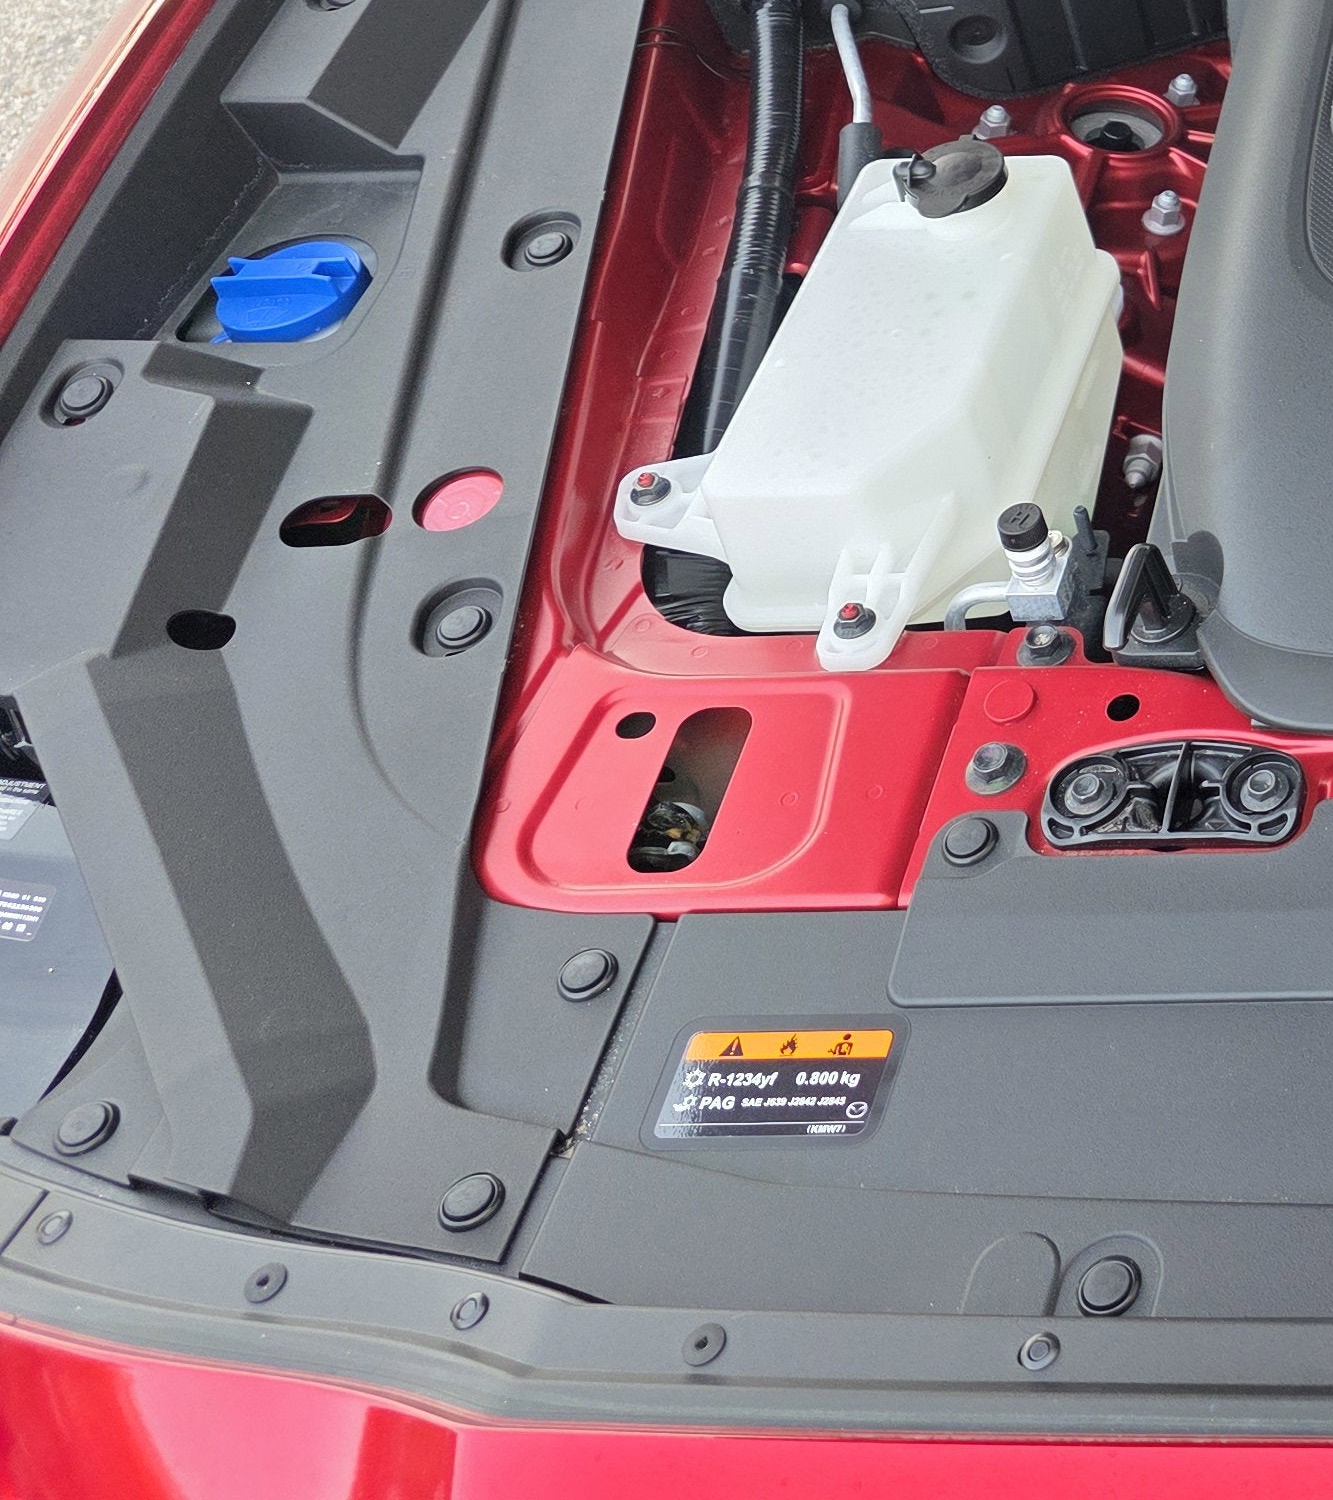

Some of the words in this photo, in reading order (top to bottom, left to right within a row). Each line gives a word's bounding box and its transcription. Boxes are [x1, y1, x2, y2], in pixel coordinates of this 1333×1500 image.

[708, 1071, 778, 1088] R-1234yf
[795, 1071, 838, 1086] 0.800
[840, 1070, 860, 1087] kg
[699, 1095, 735, 1110] PAG
[741, 1097, 763, 1107] SAE
